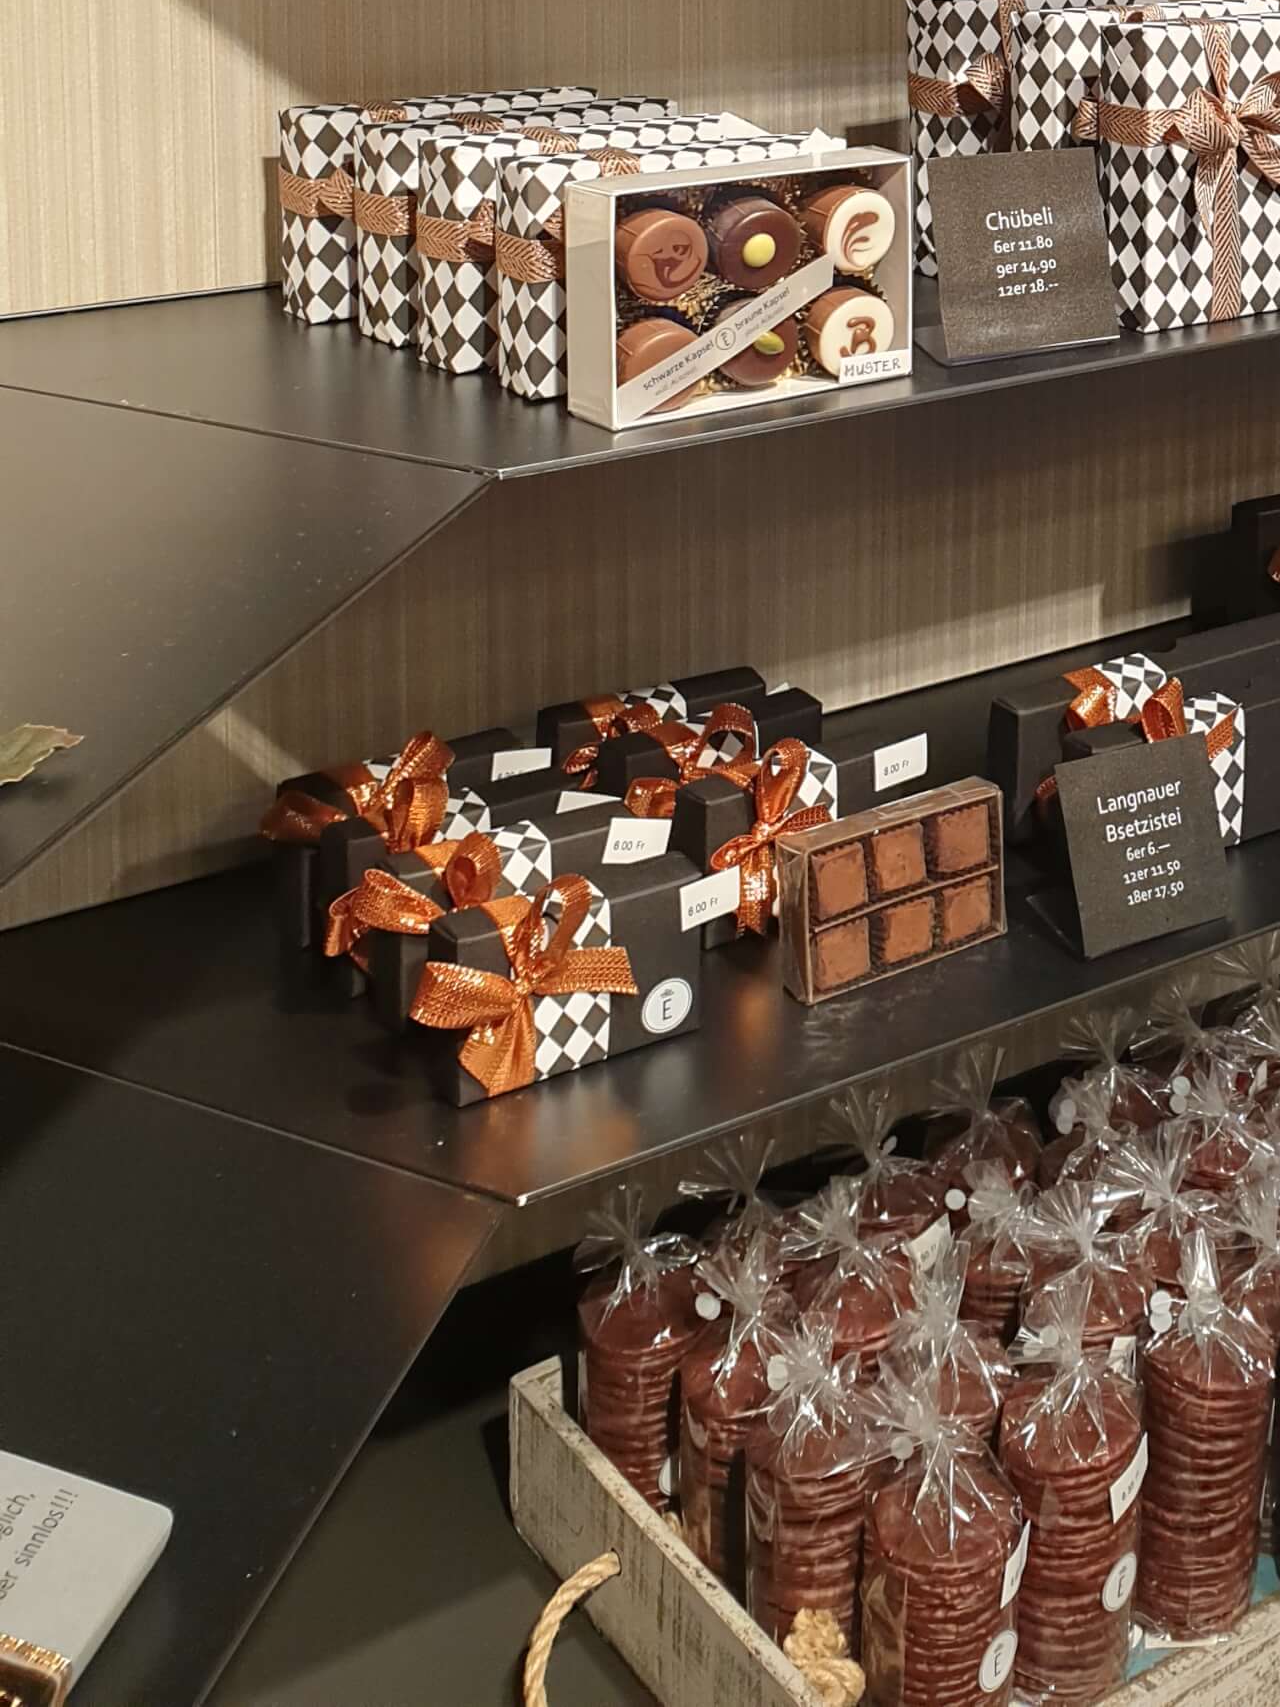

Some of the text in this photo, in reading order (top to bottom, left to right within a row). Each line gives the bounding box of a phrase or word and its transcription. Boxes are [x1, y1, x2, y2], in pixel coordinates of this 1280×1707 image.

[985, 206, 1054, 231] Chübeli
[993, 235, 1054, 254] 6er 11.80
[996, 258, 1057, 279] 9er 14.90
[998, 282, 1028, 298] 12er
[734, 307, 763, 330] braune
[763, 286, 791, 310] Kapsel
[643, 362, 685, 391] schwarze
[684, 340, 715, 364] Kapsel
[844, 357, 902, 377] MUSTER
[1096, 780, 1182, 815] Langnauer
[1105, 806, 1183, 843] Bsetzistei
[1125, 846, 1145, 862] 6er
[1122, 860, 1181, 885] 12er 11.50
[1126, 880, 1185, 906] 18er 17.50
[0, 1493, 36, 1540] glich,
[15, 1488, 78, 1567] sinnlos!!!
